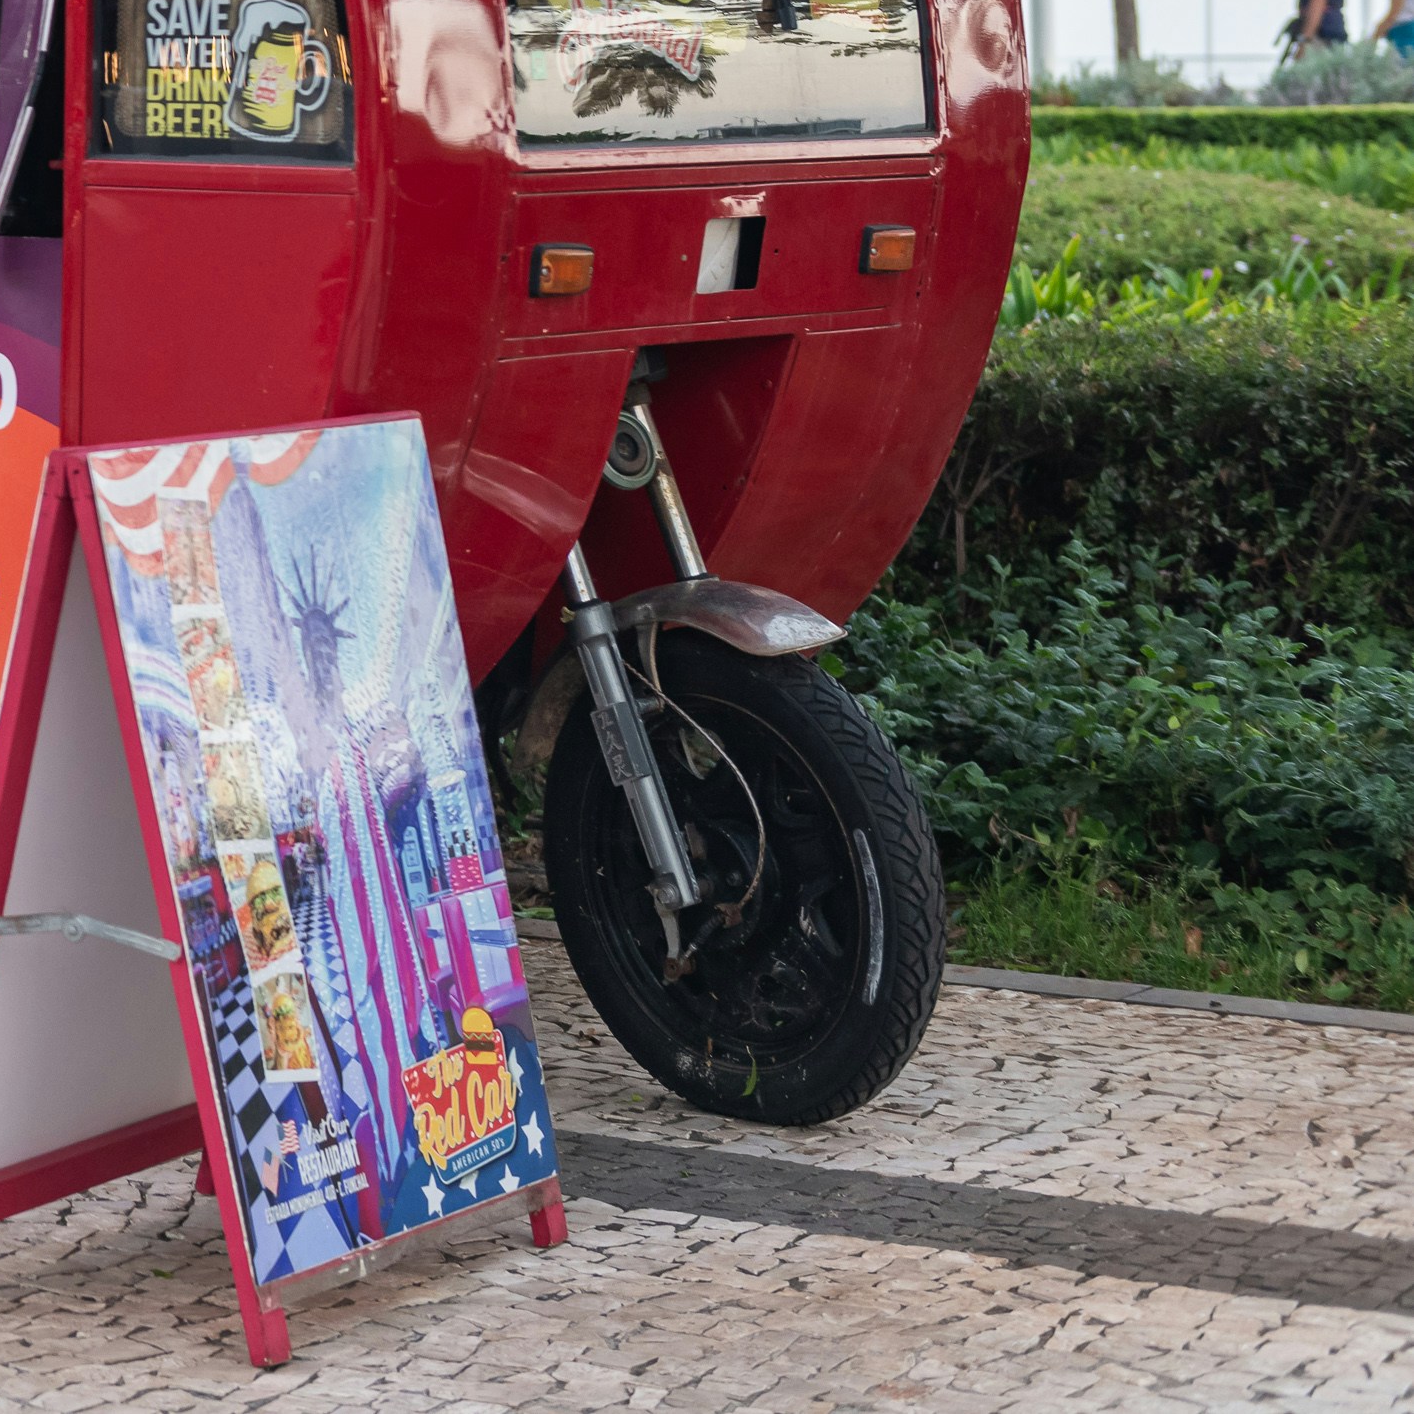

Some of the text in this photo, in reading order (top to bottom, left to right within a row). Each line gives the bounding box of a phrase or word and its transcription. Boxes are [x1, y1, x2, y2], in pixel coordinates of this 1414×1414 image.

[145, 37, 232, 68] WATER
[145, 68, 231, 102] DRINK
[145, 103, 232, 139] BEER!
[425, 1048, 464, 1099] The
[413, 1065, 517, 1171] Red Car
[296, 1138, 361, 1186] RESTAURANT
[452, 1144, 490, 1173] AMERICAN
